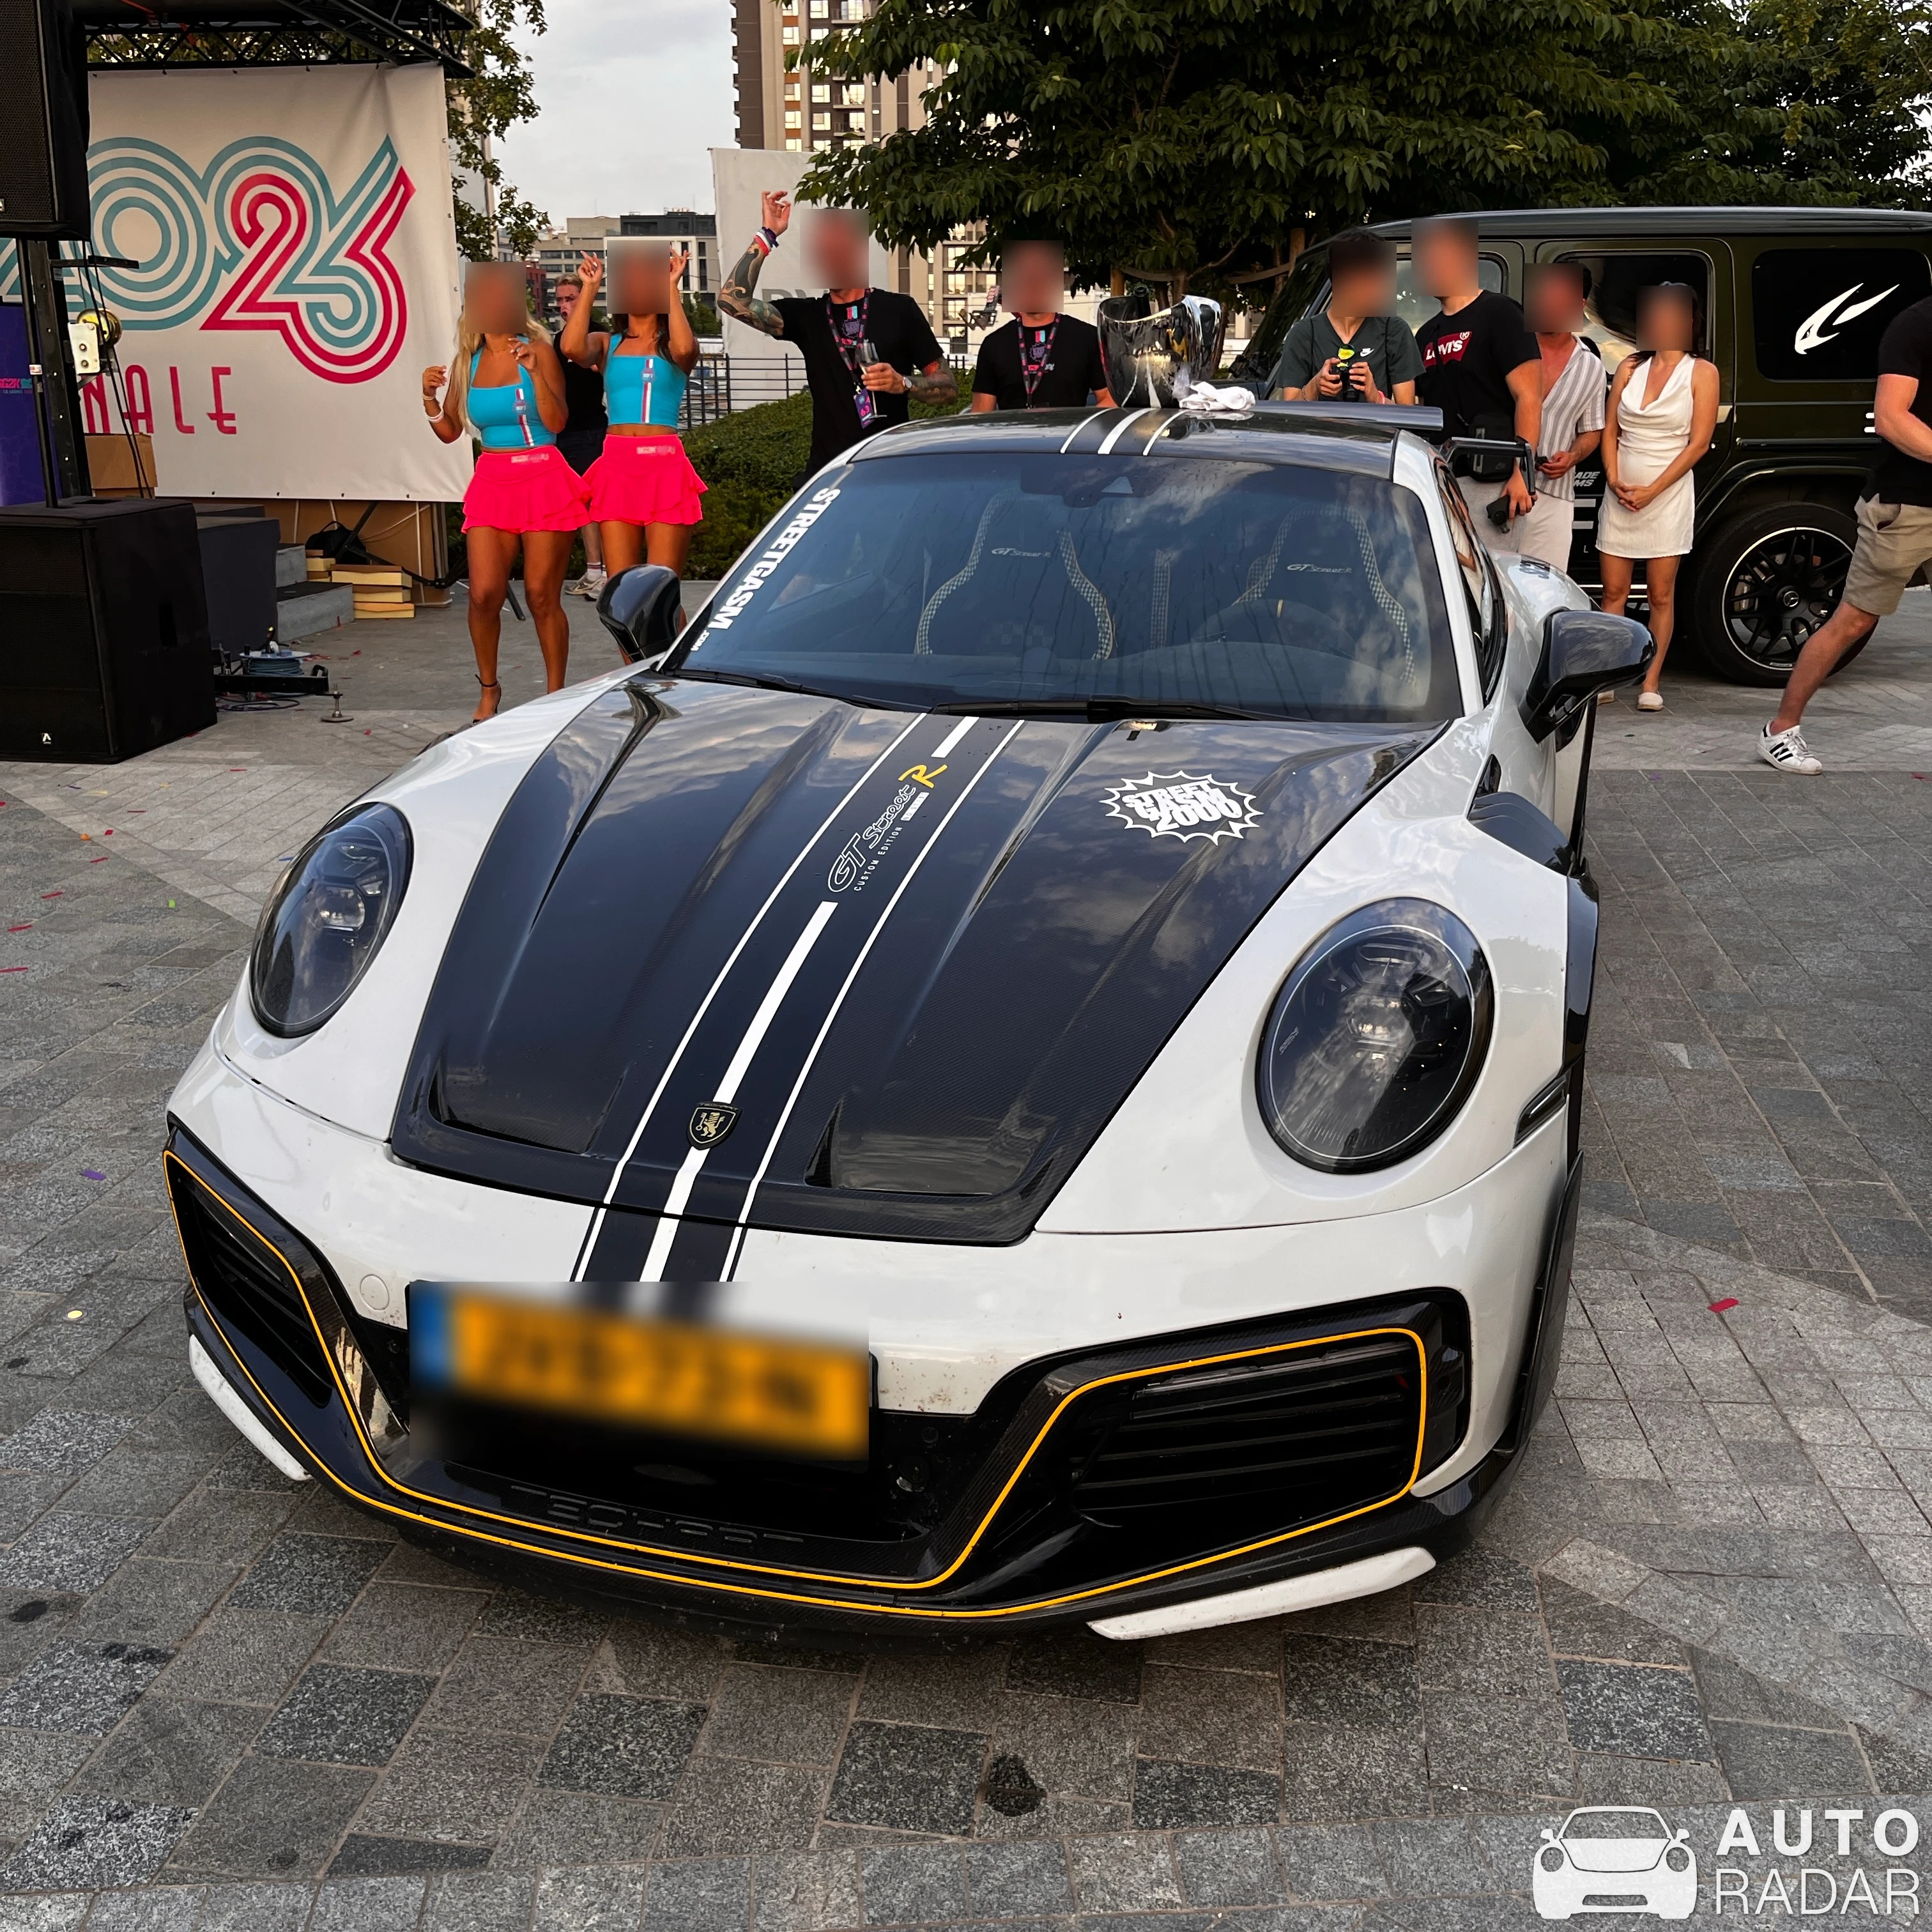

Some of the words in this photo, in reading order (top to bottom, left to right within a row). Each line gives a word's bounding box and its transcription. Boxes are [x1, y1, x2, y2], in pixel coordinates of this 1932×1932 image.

[0, 134, 416, 383] 026
[80, 364, 237, 434] NALE
[707, 487, 841, 629] STREETGASM
[1122, 779, 1211, 808] STREET
[1135, 788, 1229, 822] GASM
[1156, 799, 1243, 832] 2000
[828, 832, 866, 893] GT
[862, 785, 917, 850] Street
[898, 764, 948, 789] R
[854, 859, 880, 891] CUSTOM
[878, 827, 903, 855] EDITION
